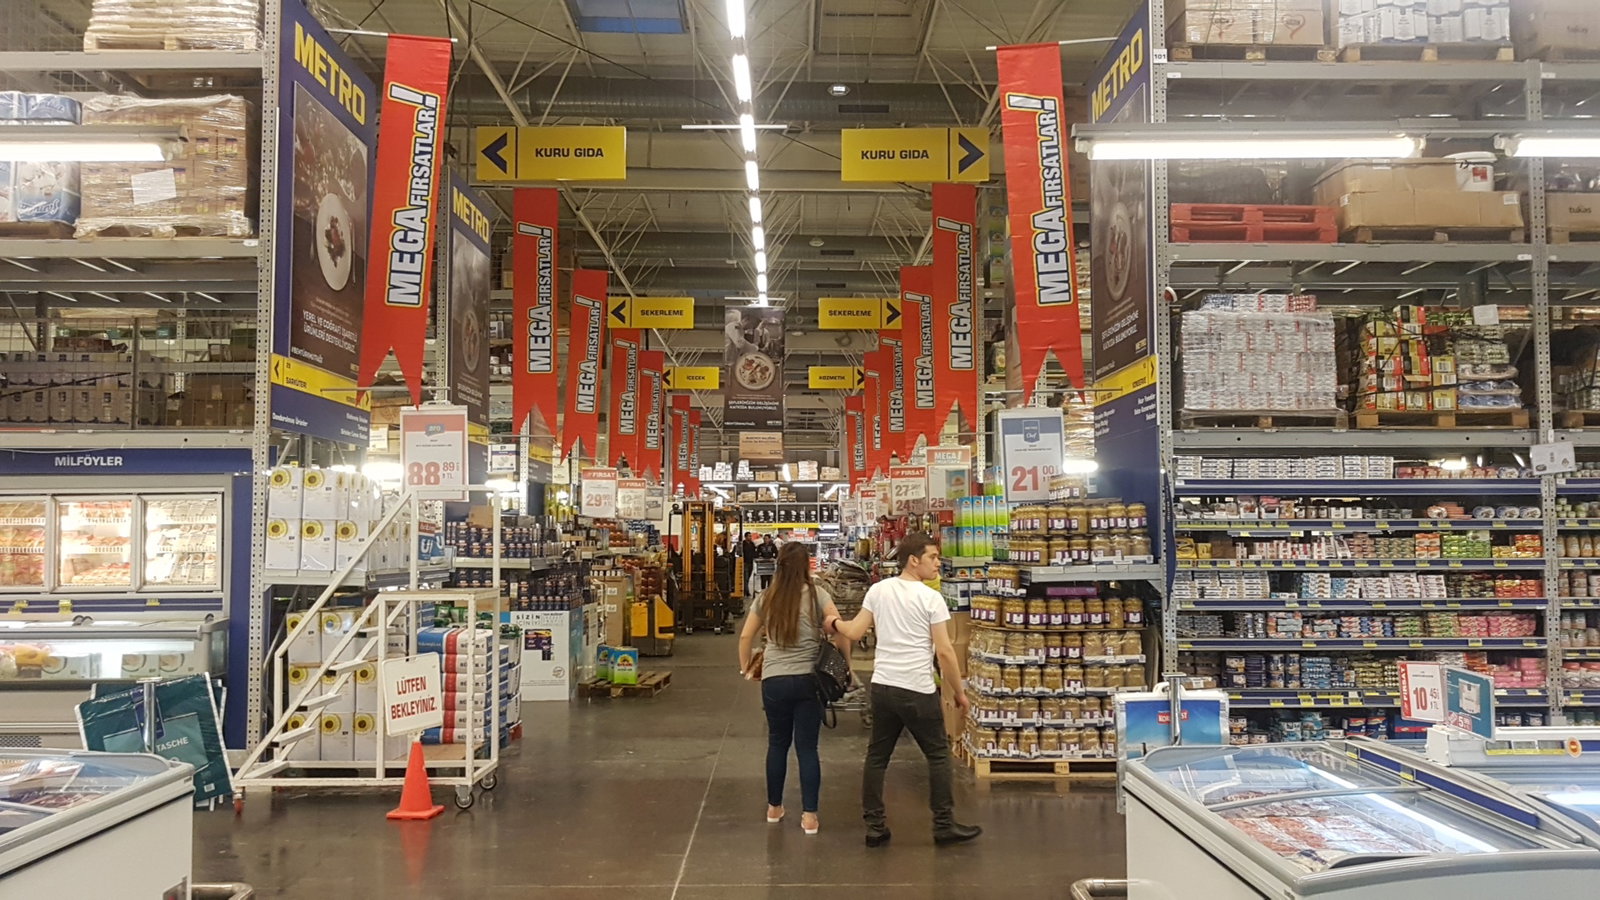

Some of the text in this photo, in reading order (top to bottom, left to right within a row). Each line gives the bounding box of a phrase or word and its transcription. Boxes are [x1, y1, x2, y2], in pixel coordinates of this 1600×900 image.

[294, 21, 366, 126] METRO
[1091, 28, 1143, 124] METRO
[535, 148, 604, 158] KURU GIDA
[861, 149, 929, 160] KURU GIDA
[386, 83, 439, 306] MEGA FIRSATLAR!
[1007, 94, 1072, 304] MEGA FIRSATLAR!
[453, 186, 490, 245] METRO
[518, 222, 553, 373] MEGA FIRSATLAR!
[938, 218, 973, 369] MEGA FIRSATLAR!
[575, 296, 601, 413] MEGA FIRSATLAR!
[905, 291, 934, 408] MEGA FIRSATLAR!
[620, 391, 635, 434] MEGA
[889, 389, 904, 432] MEGA
[647, 412, 659, 449] MEGA
[54, 454, 123, 467] MİLFÖYLER
[408, 461, 455, 486] 88 89
[895, 484, 910, 497] 27
[1011, 465, 1039, 492] 21
[586, 493, 602, 507] 29
[896, 501, 911, 512] 24
[930, 497, 945, 508] 25
[397, 675, 427, 696] LÜTFEN
[1413, 686, 1428, 711] 10
[391, 696, 438, 720] BEKLEYİNİZ.
[156, 736, 190, 753] TASCHE
